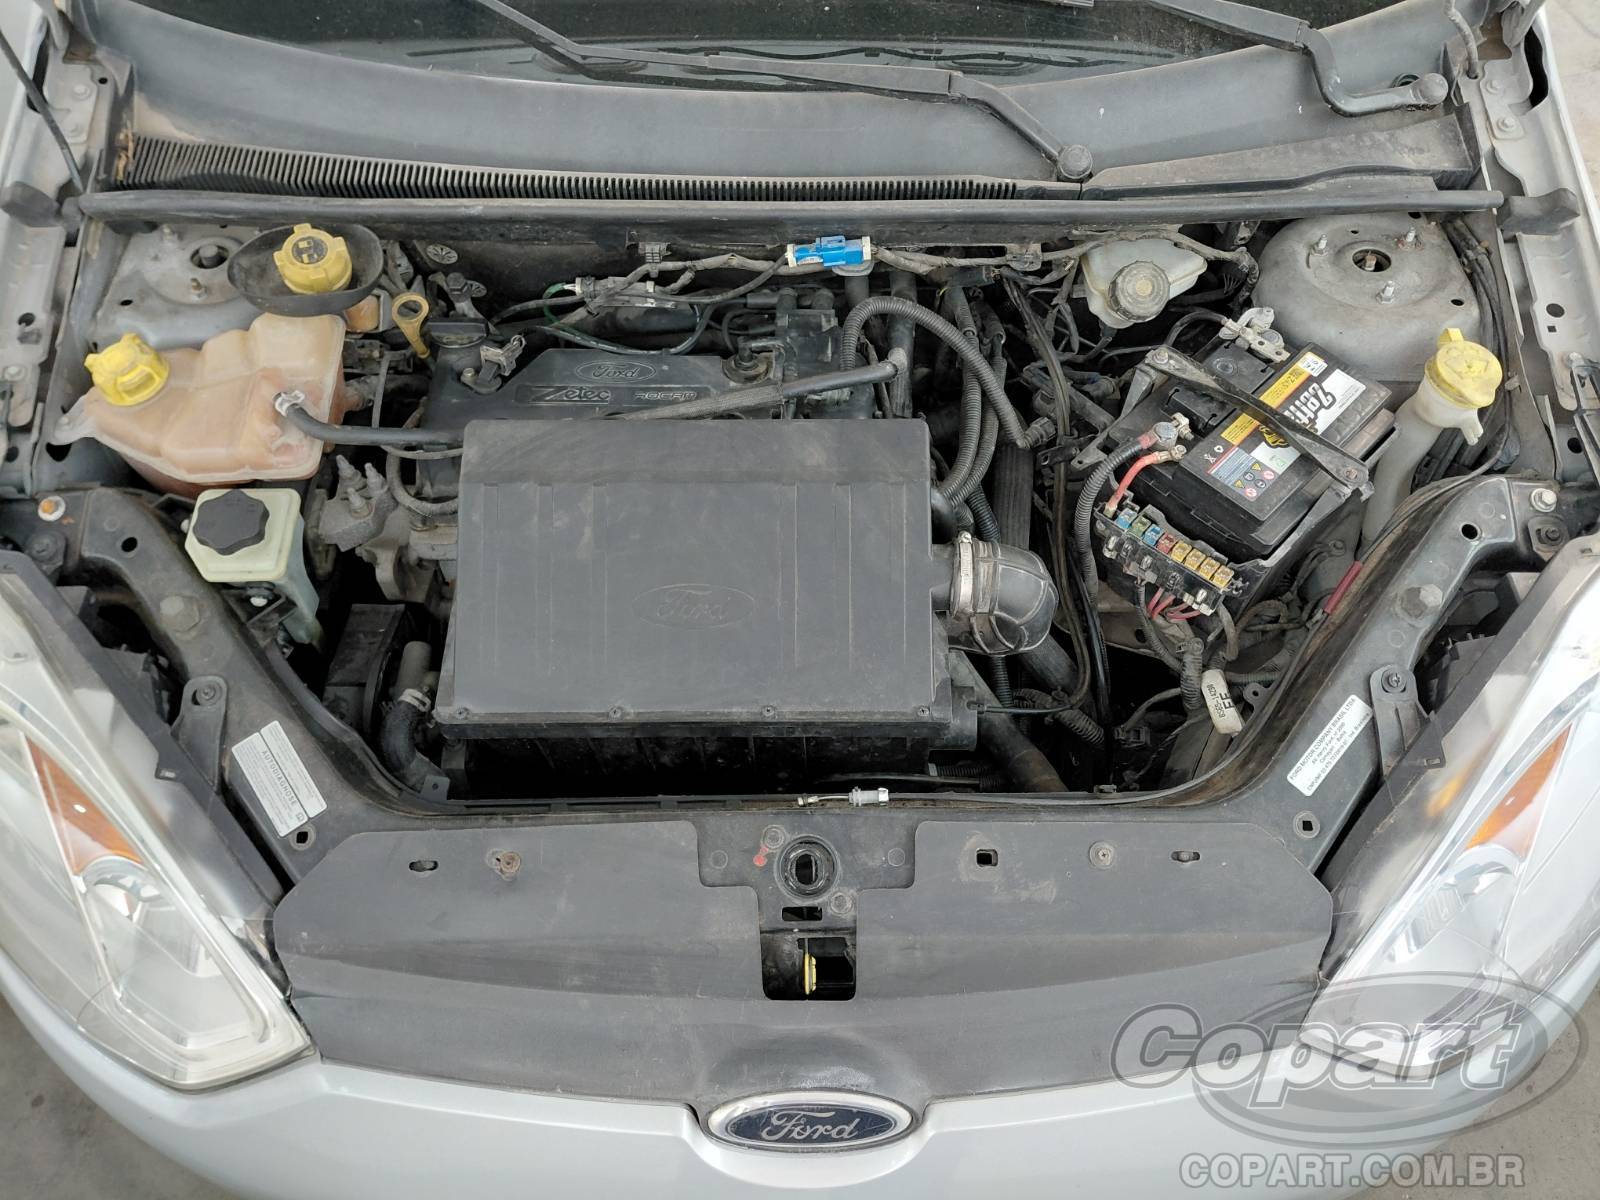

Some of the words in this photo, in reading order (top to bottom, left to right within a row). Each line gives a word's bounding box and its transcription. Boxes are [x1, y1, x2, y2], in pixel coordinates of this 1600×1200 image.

[592, 363, 641, 378] Ford
[529, 385, 611, 401] Zetec
[1289, 764, 1302, 780] FORD
[1299, 748, 1316, 767] MOTOR
[1313, 726, 1333, 750] COMPANY
[262, 750, 297, 805] AUTODIAGNOSE
[761, 1110, 861, 1141] Ford
